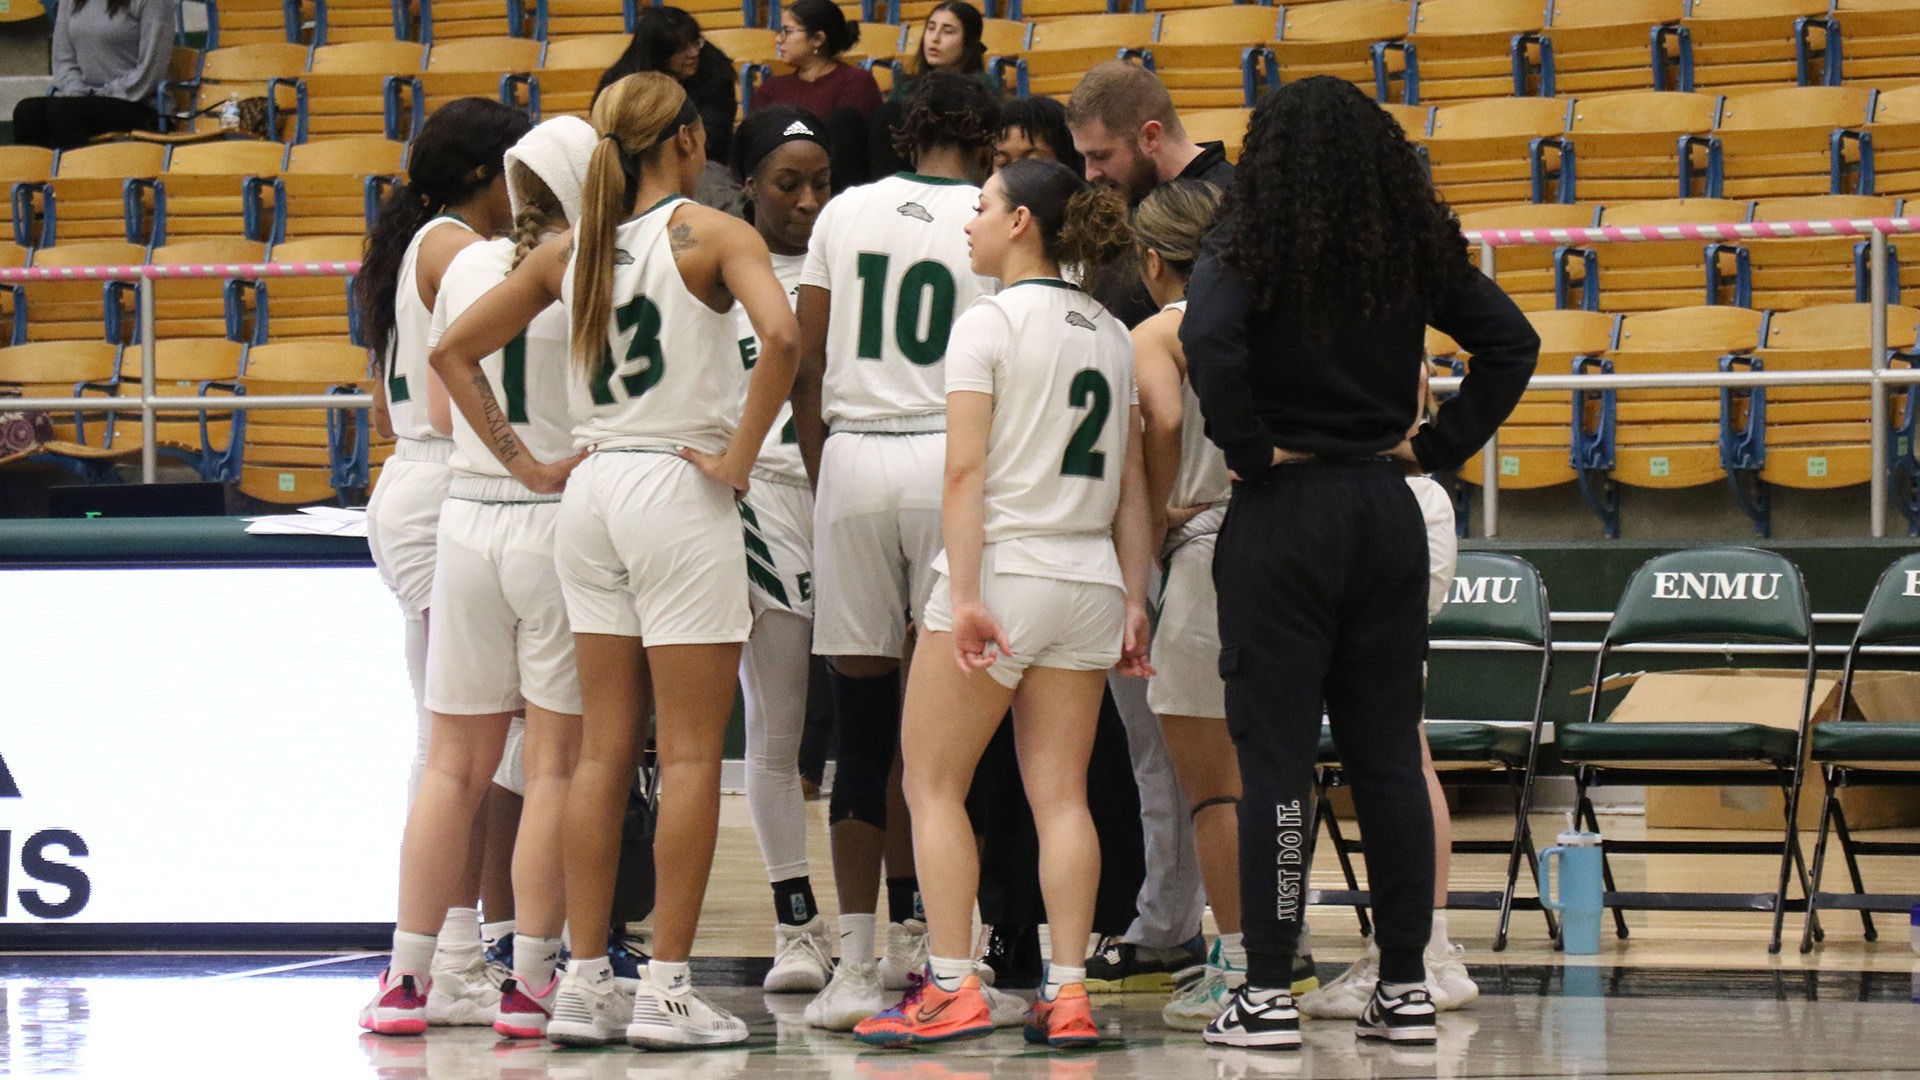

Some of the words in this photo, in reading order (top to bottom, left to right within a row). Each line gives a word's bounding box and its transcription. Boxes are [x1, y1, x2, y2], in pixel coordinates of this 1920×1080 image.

[857, 250, 956, 367] 10
[1060, 367, 1112, 481] 2
[1442, 576, 1523, 604] MU
[1651, 572, 1783, 600] ENMU
[1276, 799, 1303, 827] IT.
[1277, 830, 1303, 865] DO
[1277, 869, 1302, 921] JUST
